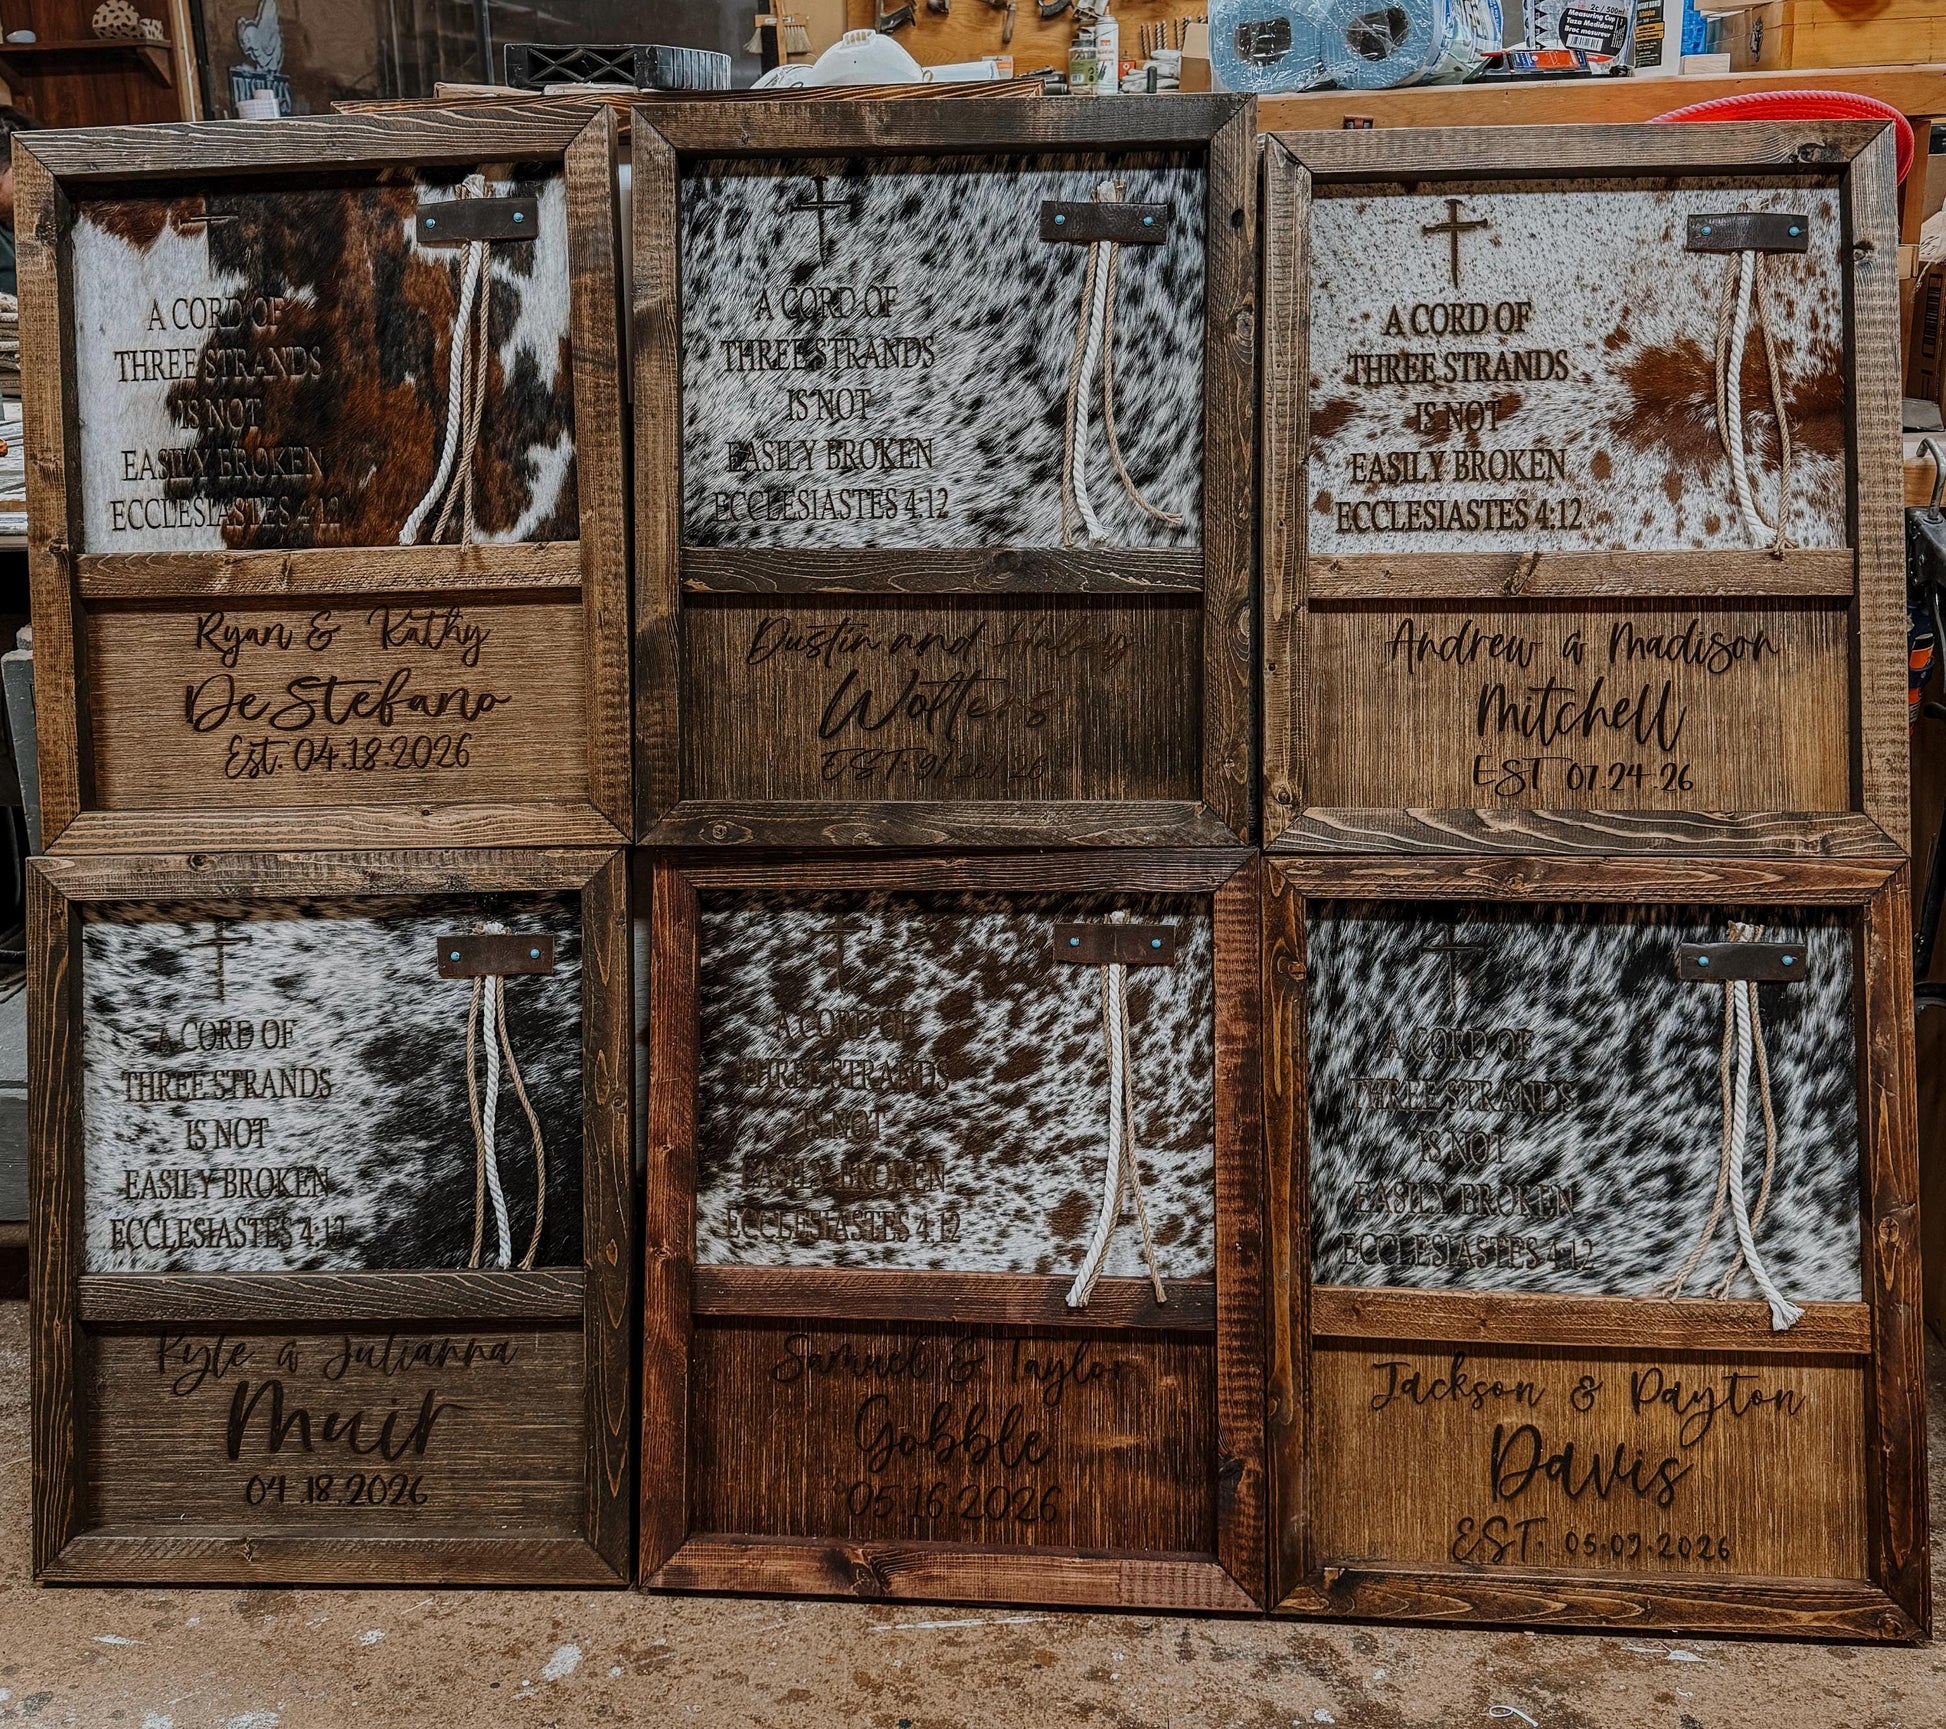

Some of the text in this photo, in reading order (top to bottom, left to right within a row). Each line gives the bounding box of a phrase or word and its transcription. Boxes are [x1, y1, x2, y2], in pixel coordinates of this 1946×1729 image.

[1566, 16, 1614, 30] Taza Medidora
[1567, 9, 1616, 23] Measuring Cup
[148, 296, 286, 331] A CORD OF
[754, 285, 898, 321] A CORD OF
[1382, 301, 1532, 336] A CORD OF
[114, 346, 322, 382] THREE STRANDS
[720, 334, 935, 372] THREE STRANDS
[1348, 349, 1569, 385] THREE STRANDS
[177, 398, 262, 430] IS NOT
[786, 388, 872, 421] IS NOT
[1413, 400, 1501, 434] IS NOT
[121, 446, 324, 481] EASILY BROKEN
[726, 437, 935, 472] EASILY BROKEN
[1350, 448, 1567, 484] EASILY BROKEN
[110, 497, 290, 531] ECCLESIASTES
[713, 487, 950, 522] ECCLESIASTES 4:12
[1335, 497, 1582, 533] ECCLESIASTES 4:12
[197, 606, 491, 668] Ryan & Kathy
[746, 616, 881, 668] Dustin
[890, 620, 988, 662] and
[1384, 617, 1543, 674] Andrew
[1609, 618, 1778, 674] Madison
[818, 669, 1062, 744] Wolters
[1477, 676, 1687, 751] Mitchell
[225, 732, 472, 779] Est. 04.18.2026
[1472, 754, 1694, 797] EST 07.24.26
[158, 1019, 297, 1051] A CORD OF
[776, 1008, 916, 1041] A CORD OF
[1384, 1027, 1535, 1062] A CORD OF
[122, 1067, 332, 1102] THREE STRANDS
[739, 1058, 950, 1092] THREE STRANDS
[1346, 1078, 1579, 1116] THREE STRANDS
[184, 1118, 269, 1150] IS NOT
[800, 1109, 886, 1140] IS NOT
[1417, 1130, 1508, 1165] IS NOT
[124, 1166, 330, 1200] EASILY BROKEN
[740, 1158, 832, 1189] EASILY
[1354, 1181, 1574, 1219] EASILY BROKEN
[110, 1216, 346, 1251] ECCLESIASTES 4:12
[726, 1207, 909, 1243] ECCLESIASTES
[1339, 1232, 1541, 1270] ECCLESIASTES
[156, 1330, 255, 1397] Kyle
[323, 1329, 521, 1381] Julianna
[771, 1333, 1138, 1407] Samuel & Taylor
[1371, 1350, 1806, 1449] Jackson & Payton
[227, 1379, 466, 1462] Muir
[854, 1394, 1057, 1473] Gobble
[1491, 1424, 1693, 1510] Davis
[245, 1473, 429, 1506] 04.18.2026
[848, 1481, 1062, 1523] 05.16.2026
[1452, 1516, 1548, 1562] EST.
